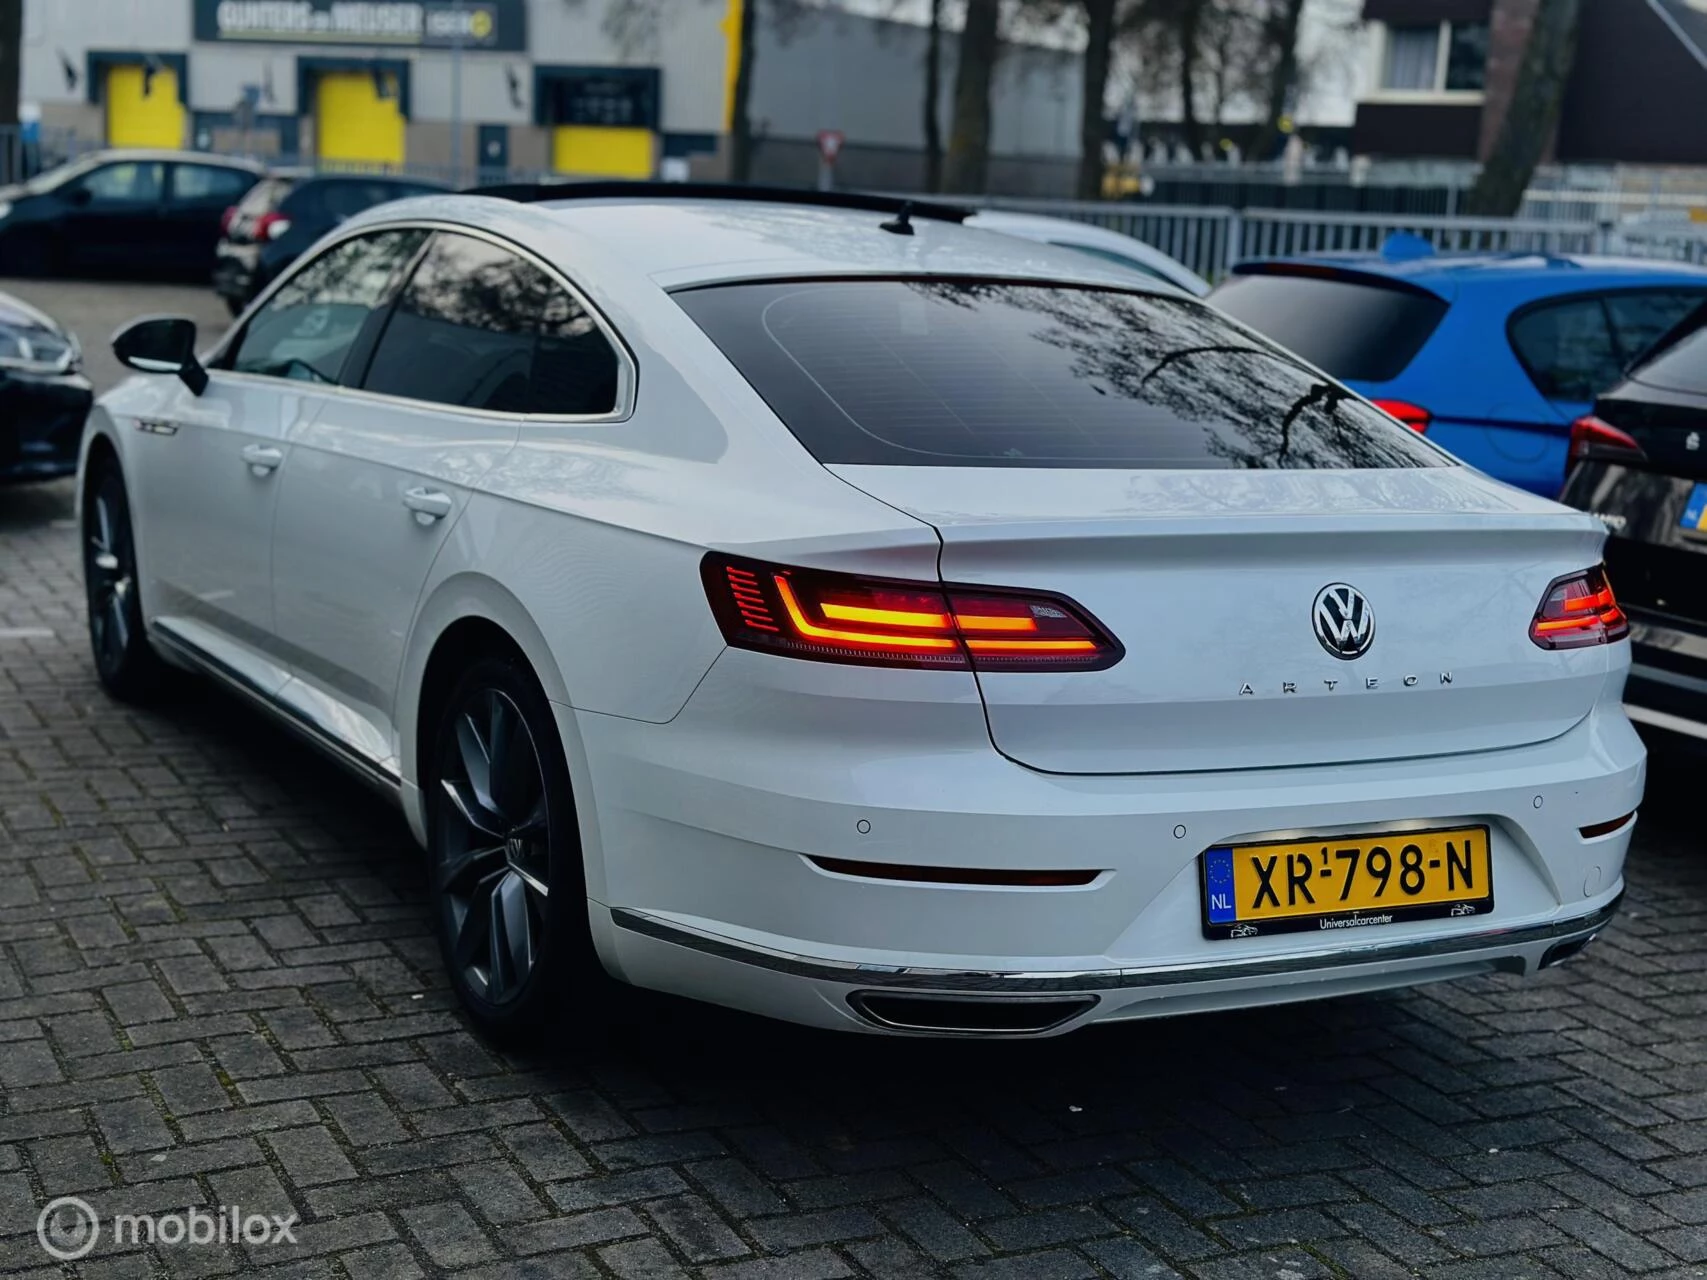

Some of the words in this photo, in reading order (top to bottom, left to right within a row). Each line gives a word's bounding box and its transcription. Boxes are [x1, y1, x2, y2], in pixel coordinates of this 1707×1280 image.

[1239, 672, 1453, 695] ARTEON
[1211, 893, 1232, 910] NL
[1320, 914, 1393, 929] Universalcarcenter
